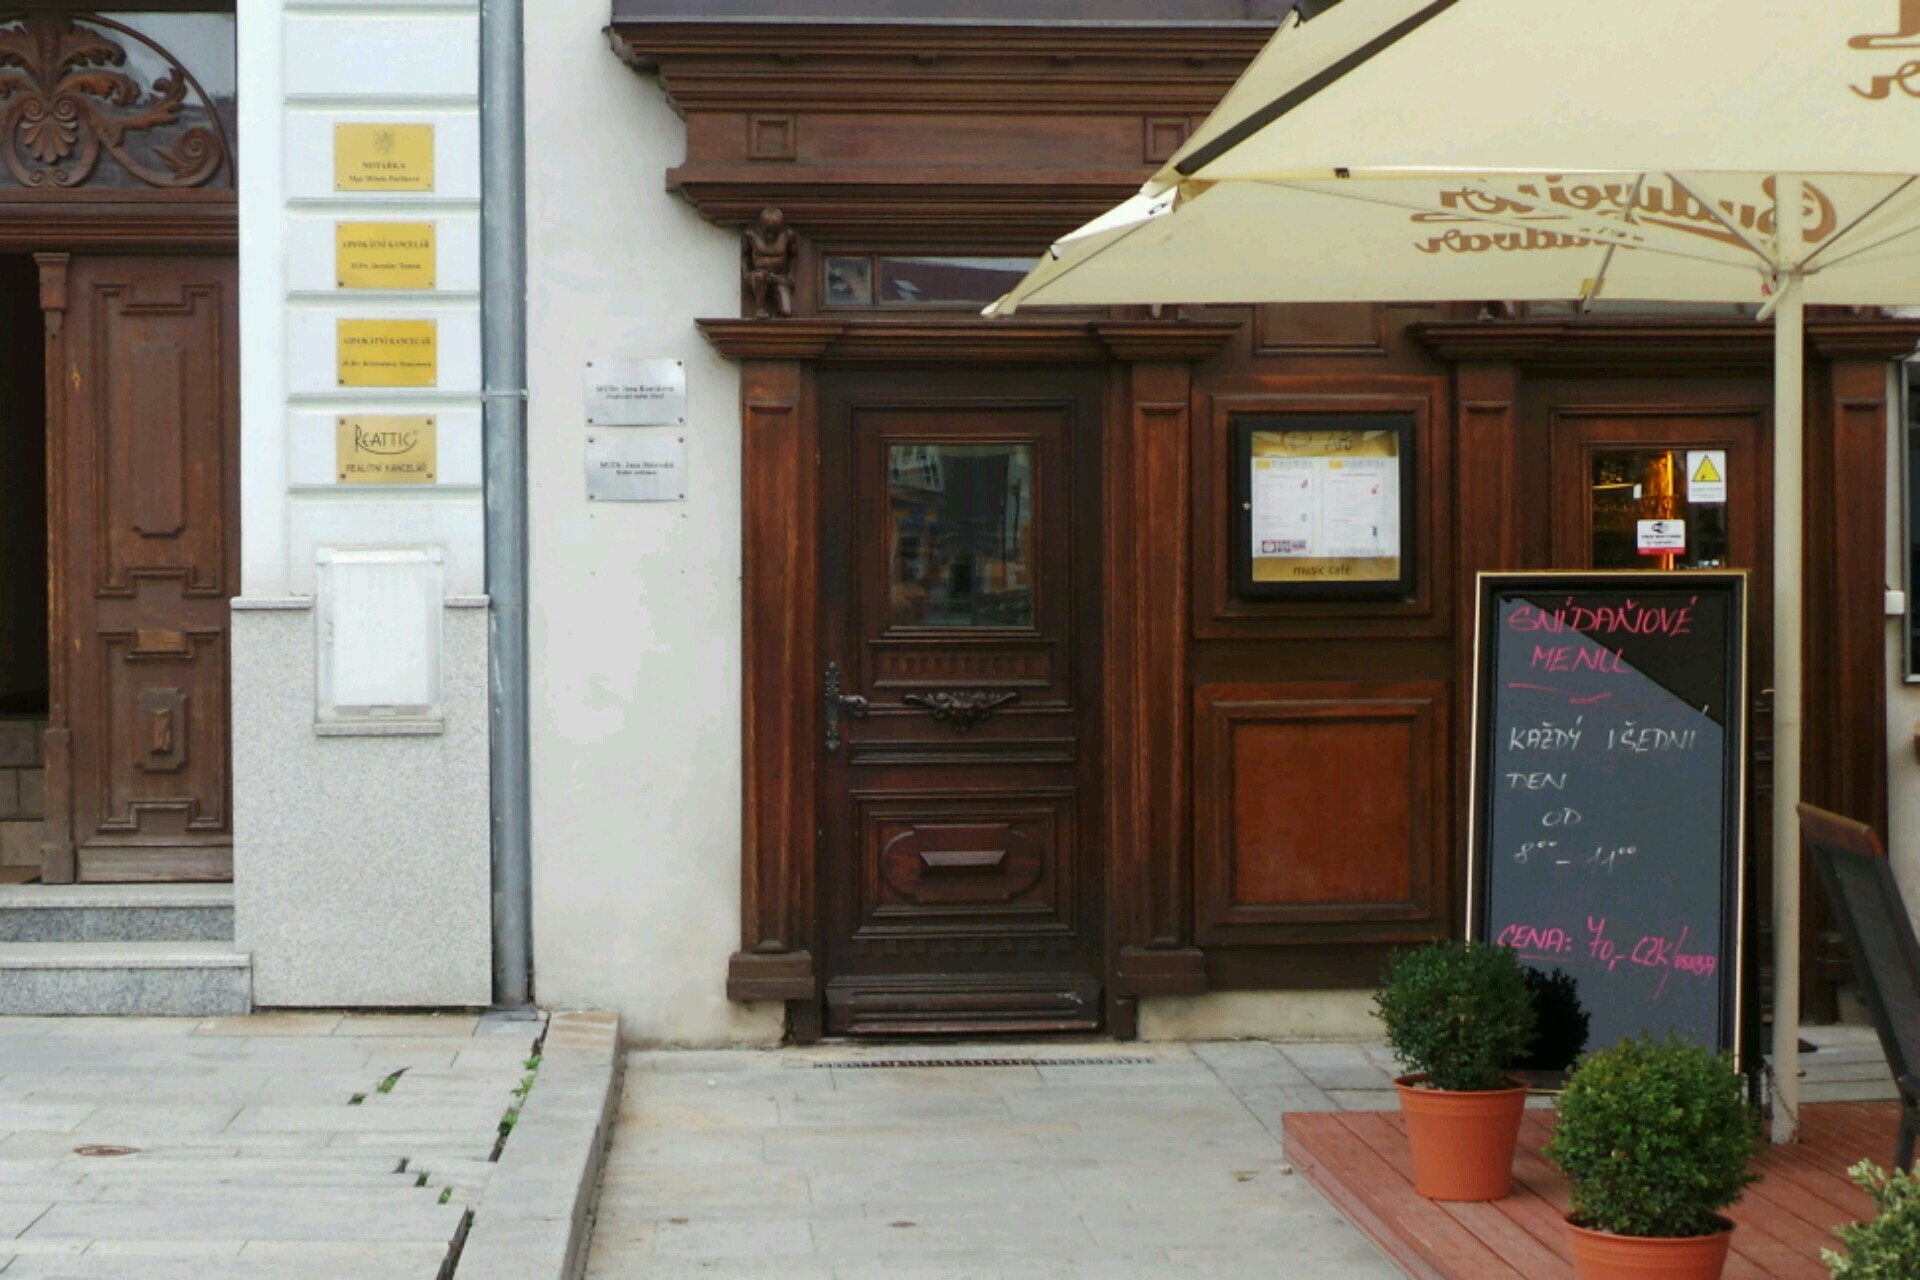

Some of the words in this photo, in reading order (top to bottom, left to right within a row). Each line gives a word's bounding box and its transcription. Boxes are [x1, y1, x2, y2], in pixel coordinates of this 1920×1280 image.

[1293, 565, 1325, 576] music
[1531, 645, 1630, 673] MENU
[1509, 715, 1583, 750] KAŽDÝ
[1505, 772, 1567, 799] DEN
[1542, 807, 1582, 826] OD
